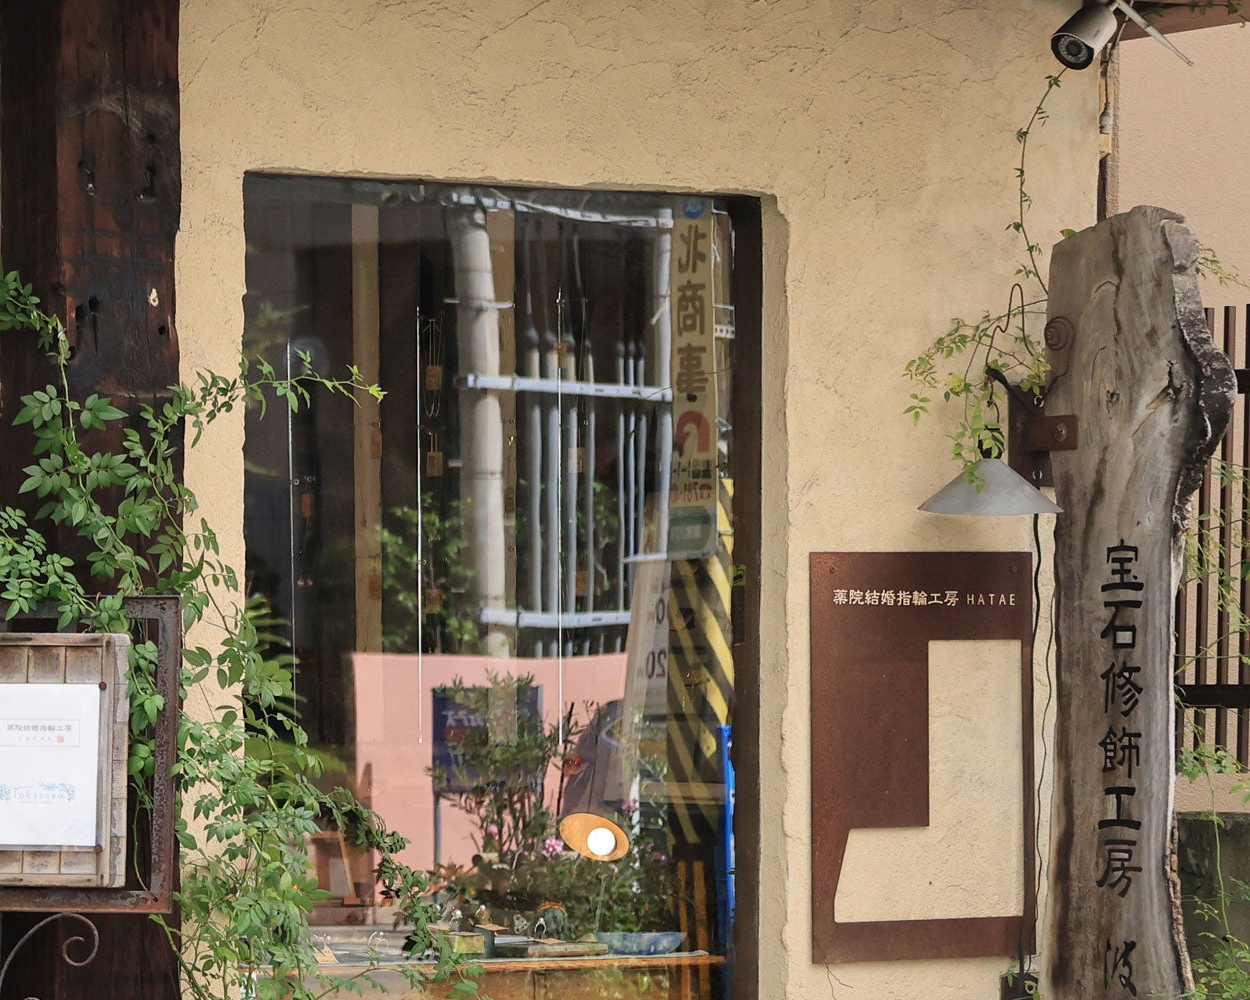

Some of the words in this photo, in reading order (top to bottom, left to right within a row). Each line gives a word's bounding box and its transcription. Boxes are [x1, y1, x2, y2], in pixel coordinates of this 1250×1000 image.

[833, 589, 959, 607] 薬院結婚指輪工房
[966, 593, 1016, 606] HATAE
[1096, 538, 1145, 898] 宝石修飾工房
